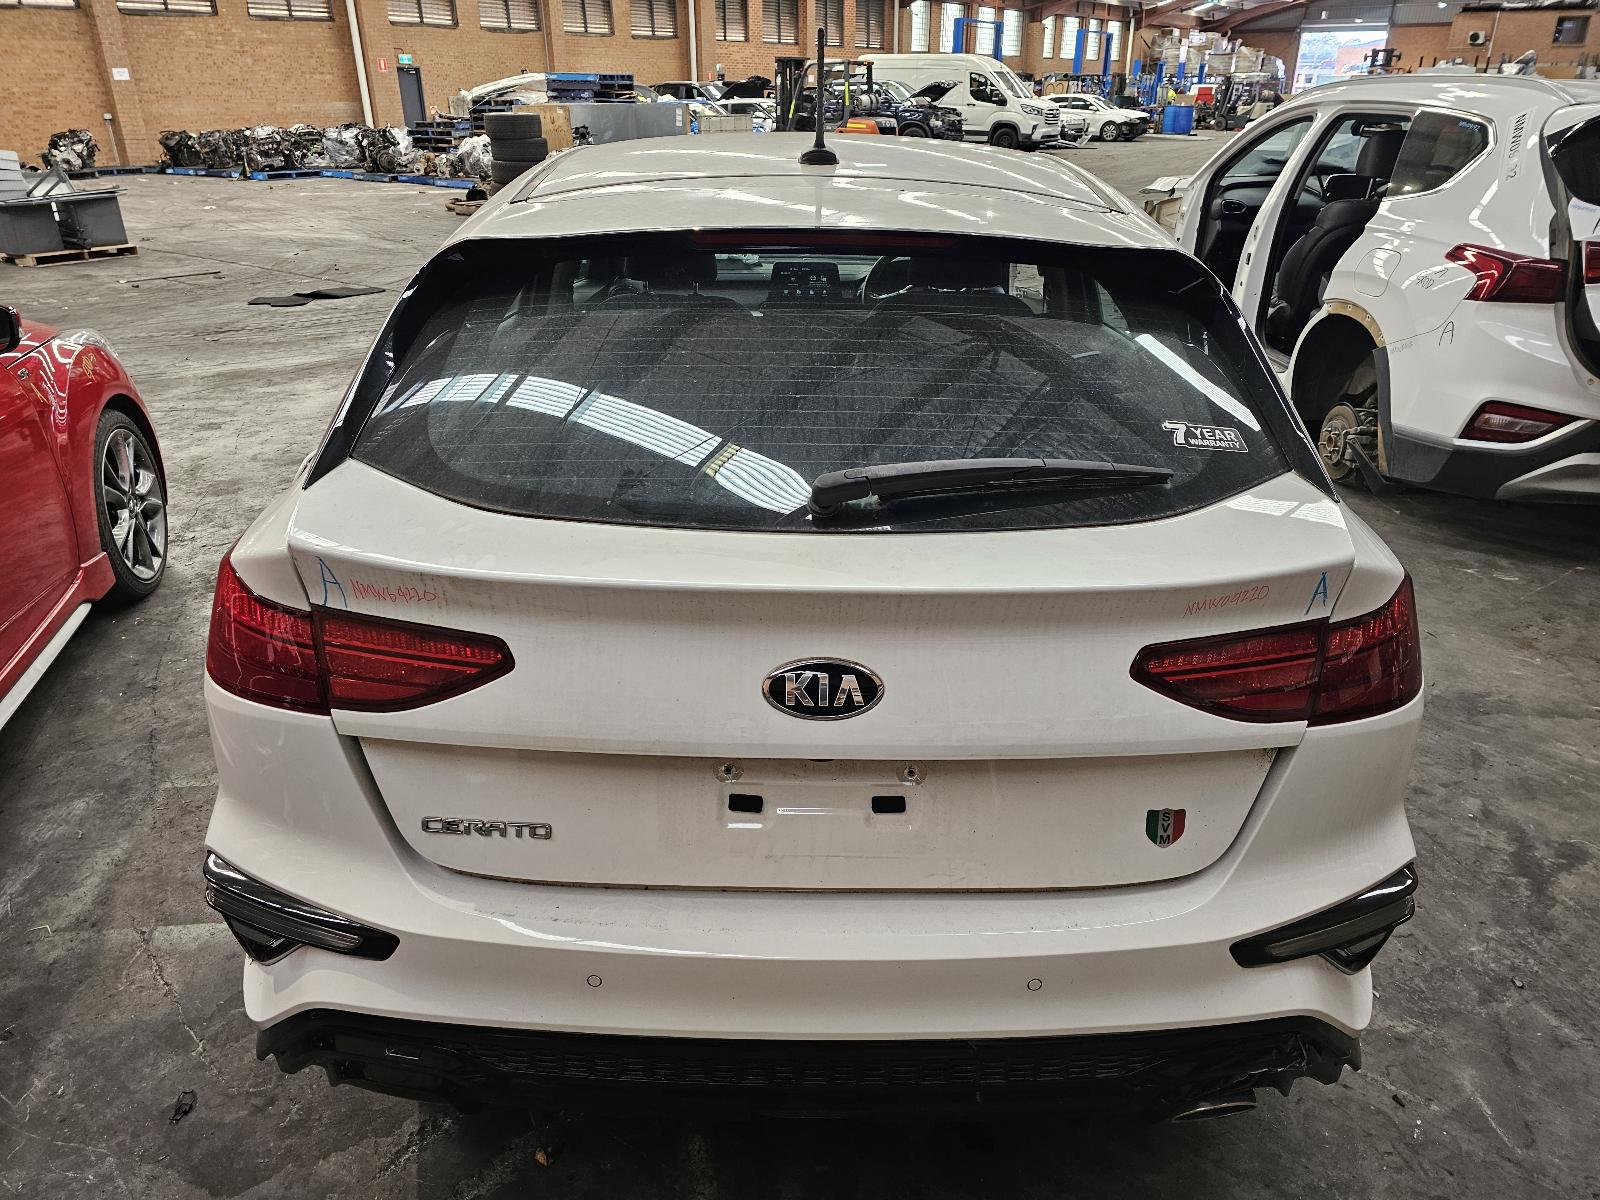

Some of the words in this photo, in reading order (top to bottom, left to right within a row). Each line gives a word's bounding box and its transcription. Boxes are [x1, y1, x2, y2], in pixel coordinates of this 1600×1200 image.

[1438, 320, 1455, 346] A
[1162, 421, 1187, 444] 7
[1190, 427, 1239, 442] YEAR
[1188, 437, 1240, 449] WARRANTY
[315, 555, 348, 608] A
[1304, 571, 1328, 616] A
[783, 671, 865, 706] KIA
[421, 816, 552, 840] CERATO
[1158, 811, 1171, 845] SVM
